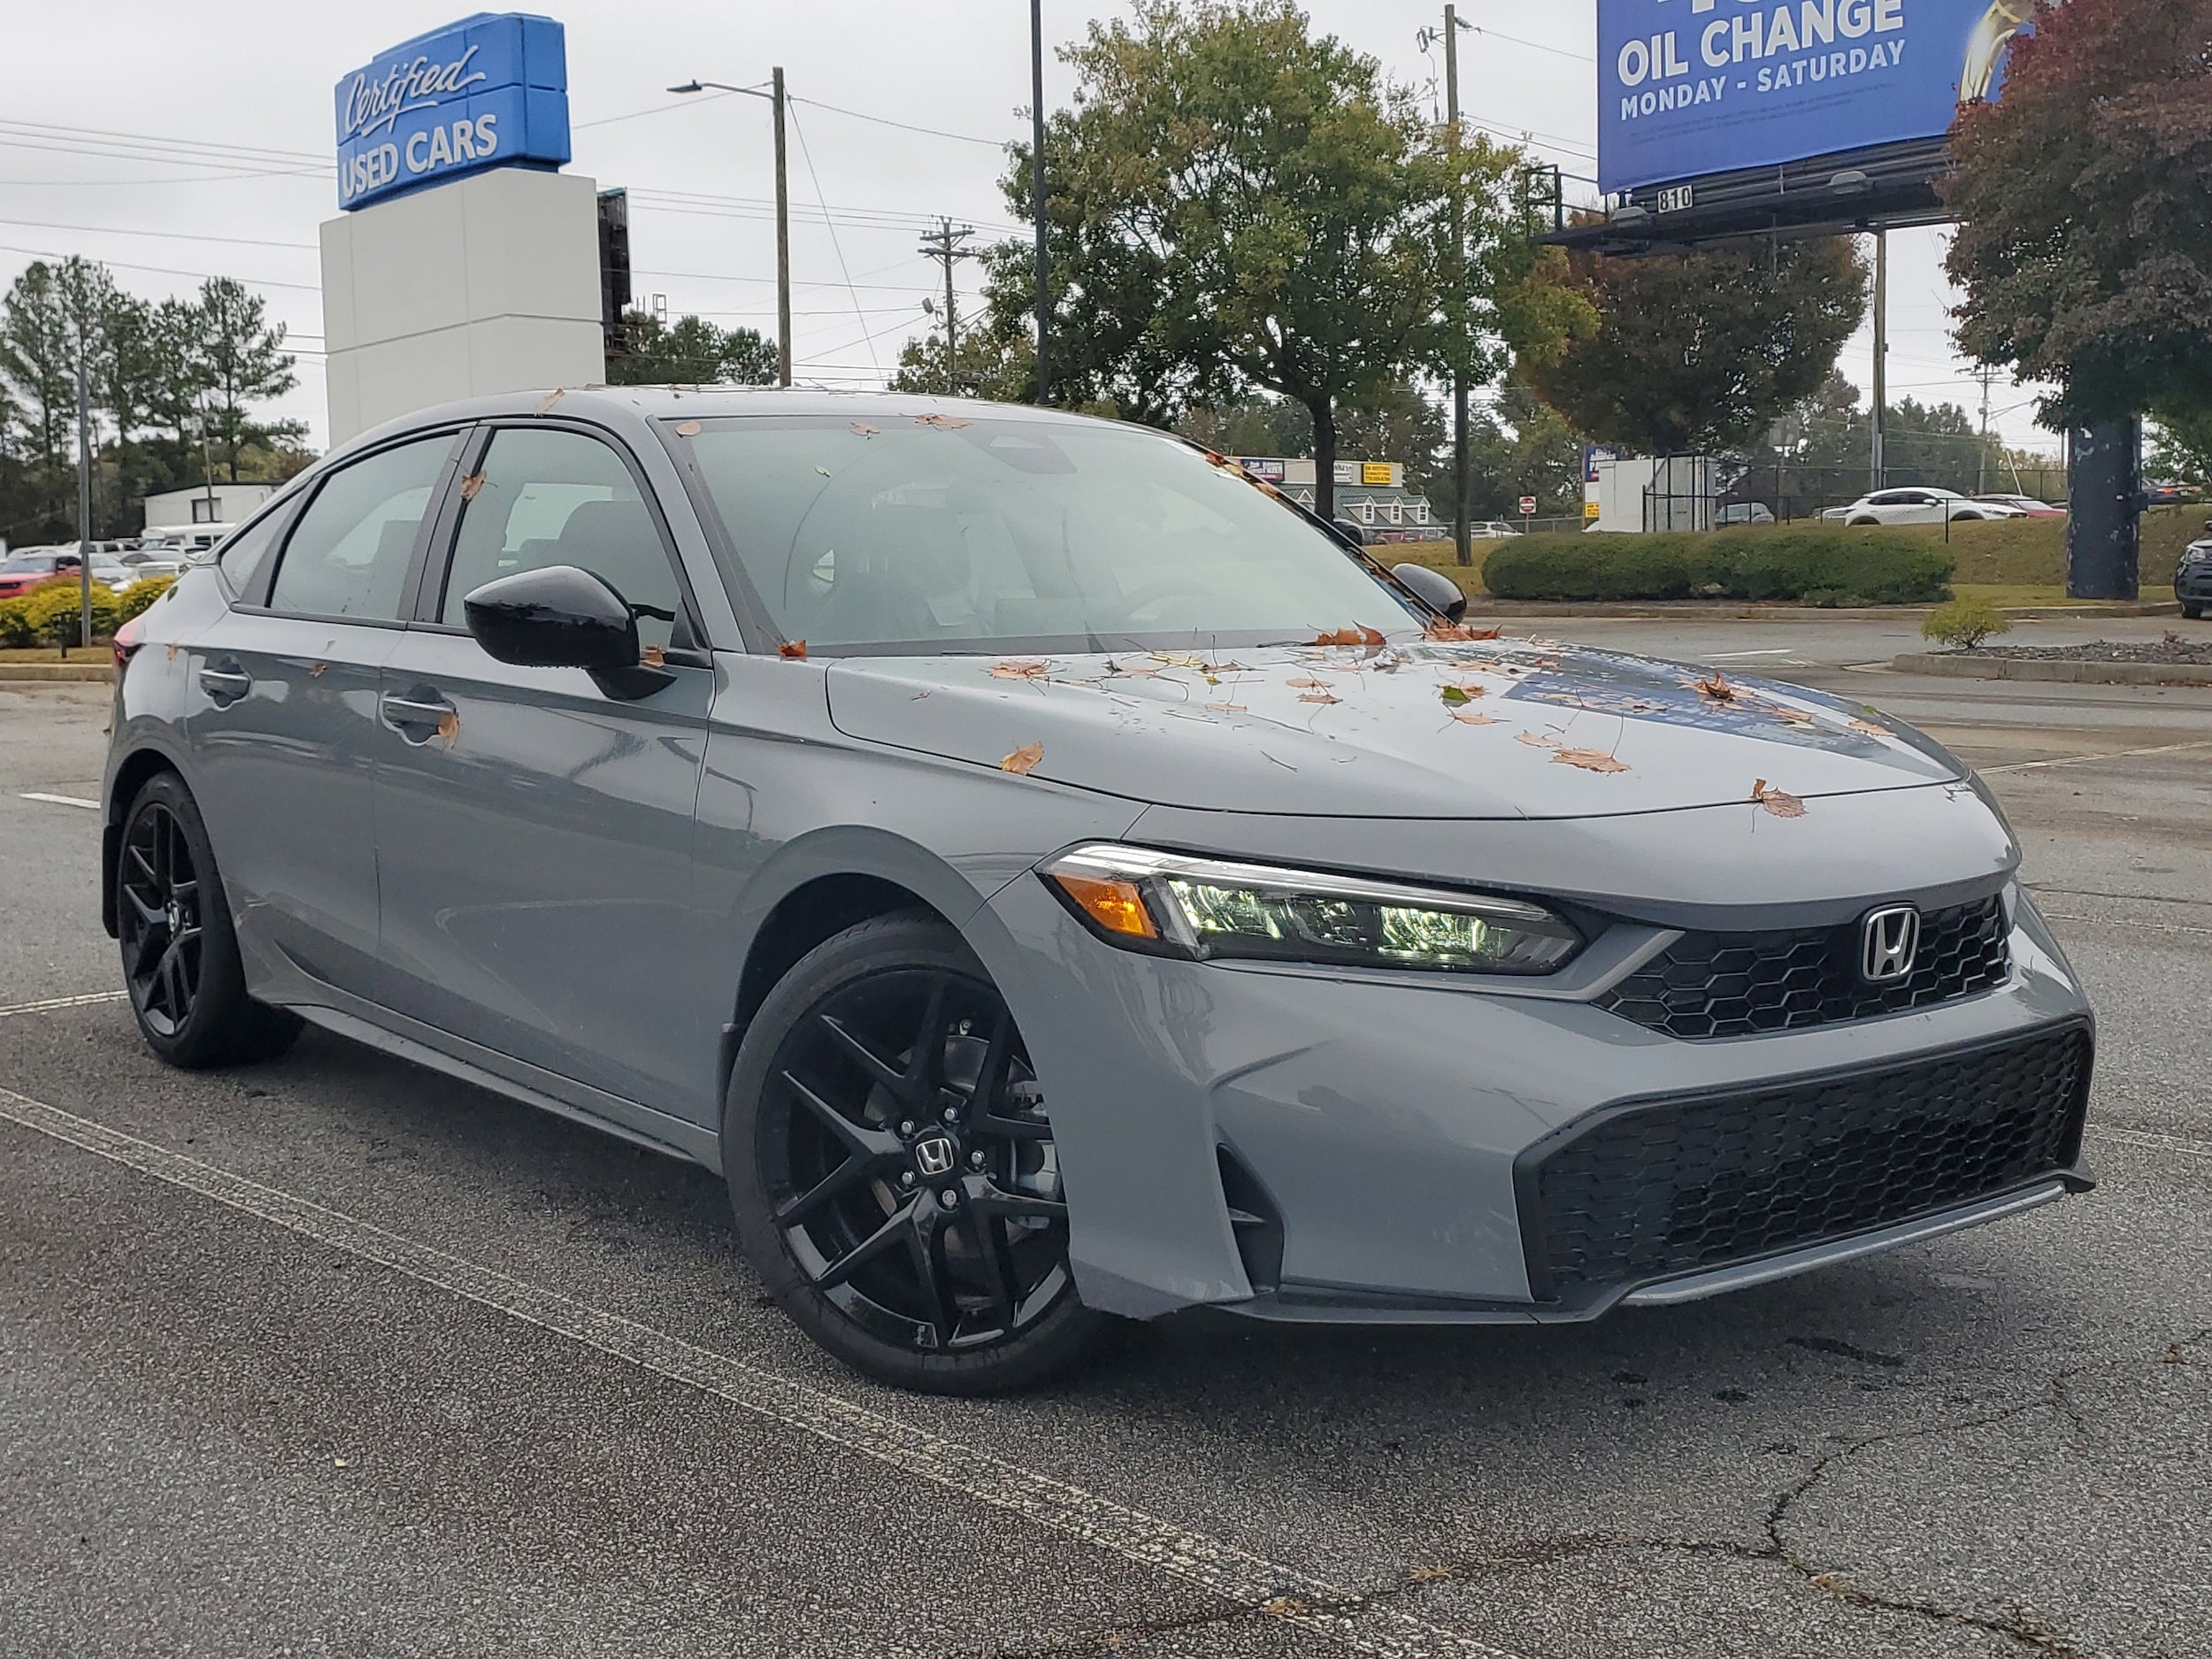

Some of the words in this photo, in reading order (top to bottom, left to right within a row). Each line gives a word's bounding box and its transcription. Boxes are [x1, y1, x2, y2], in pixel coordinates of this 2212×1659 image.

[1617, 30, 1689, 87] OIL
[1701, 0, 1904, 67] CHANGE
[1621, 75, 1727, 121] MONDAY
[1737, 81, 1747, 90] -
[1756, 39, 1906, 92] SATURDAY
[345, 45, 486, 137] Certified
[342, 142, 399, 199] USED
[405, 113, 497, 173] CARS
[1660, 187, 1691, 211] 810
